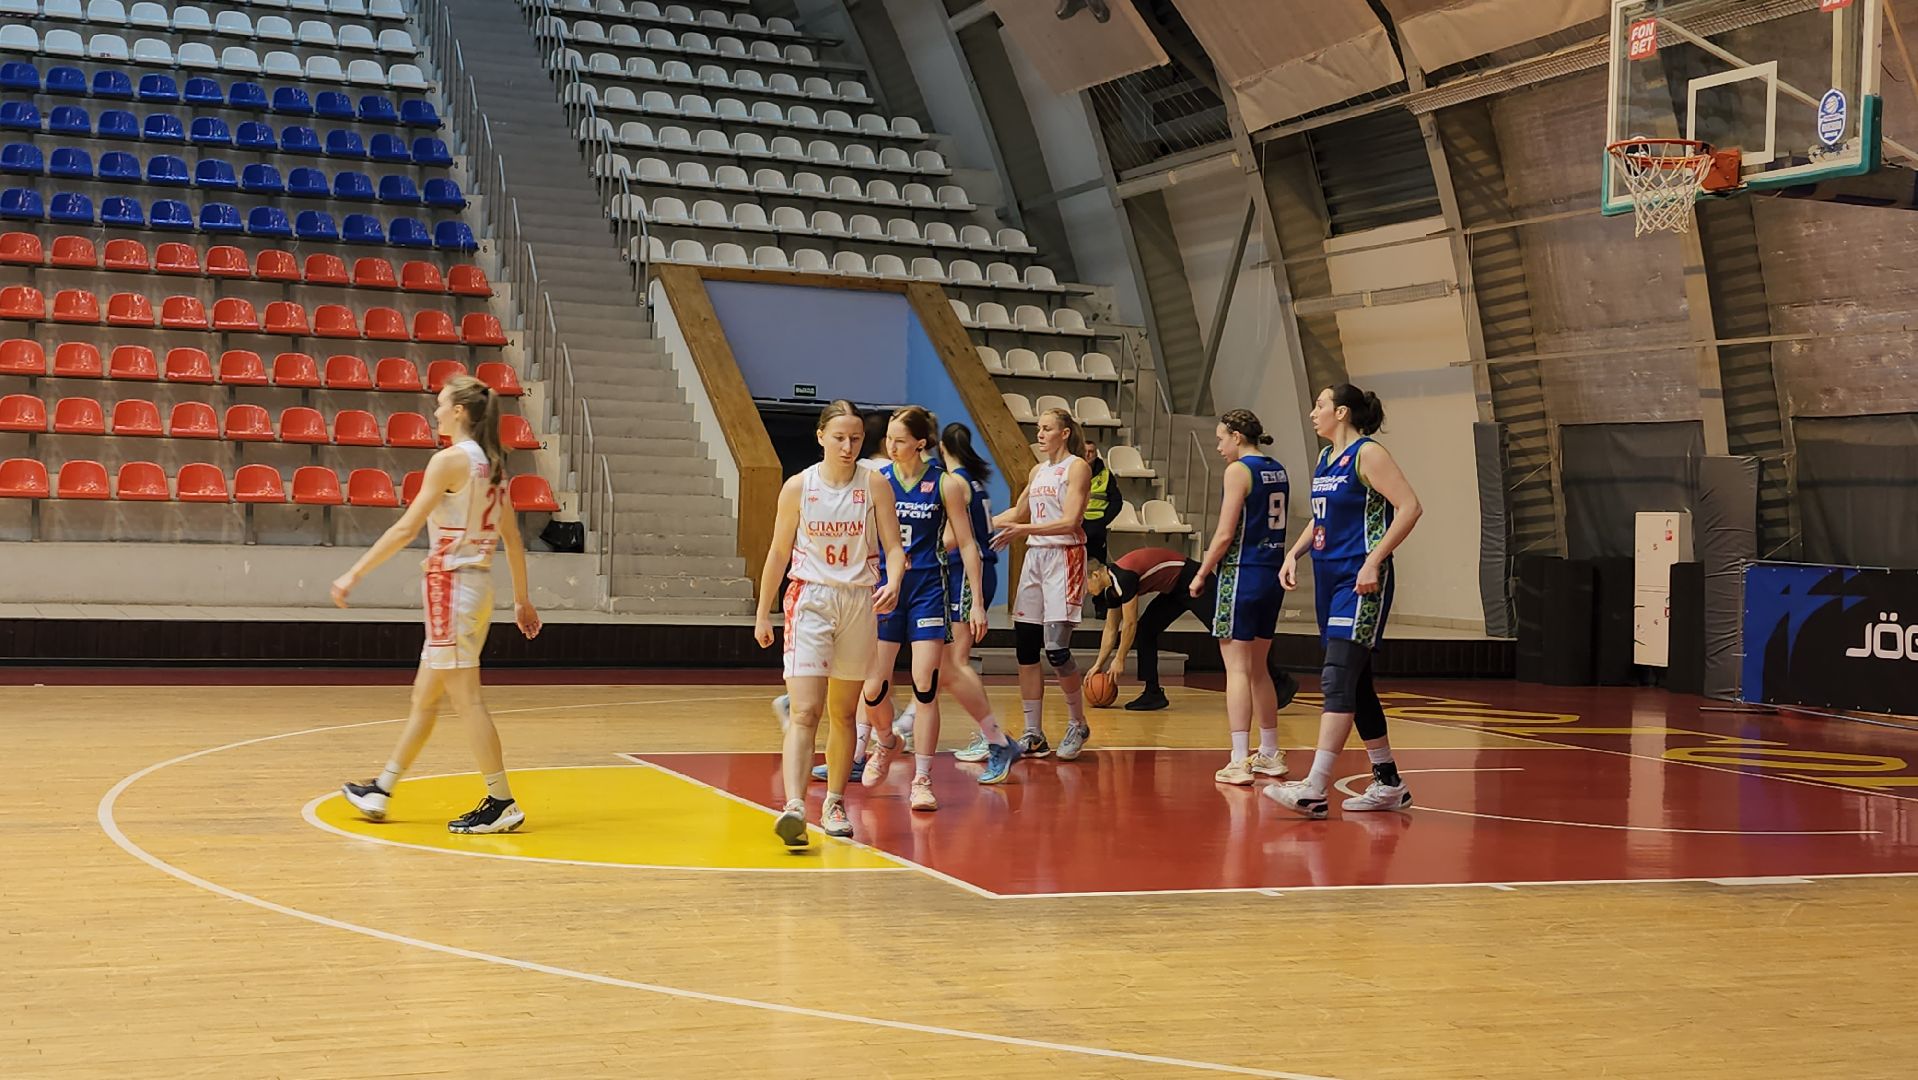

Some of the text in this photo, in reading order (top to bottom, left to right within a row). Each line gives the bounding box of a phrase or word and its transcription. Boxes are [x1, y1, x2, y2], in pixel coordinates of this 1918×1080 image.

[1631, 22, 1655, 40] FON
[1631, 35, 1655, 56] BET
[482, 245, 488, 253] 6
[542, 441, 548, 450] 2
[562, 501, 567, 510] 1
[1036, 502, 1046, 518] 12
[1268, 492, 1286, 530] 9
[808, 520, 864, 532] СПАРТАК
[825, 544, 848, 567] 64
